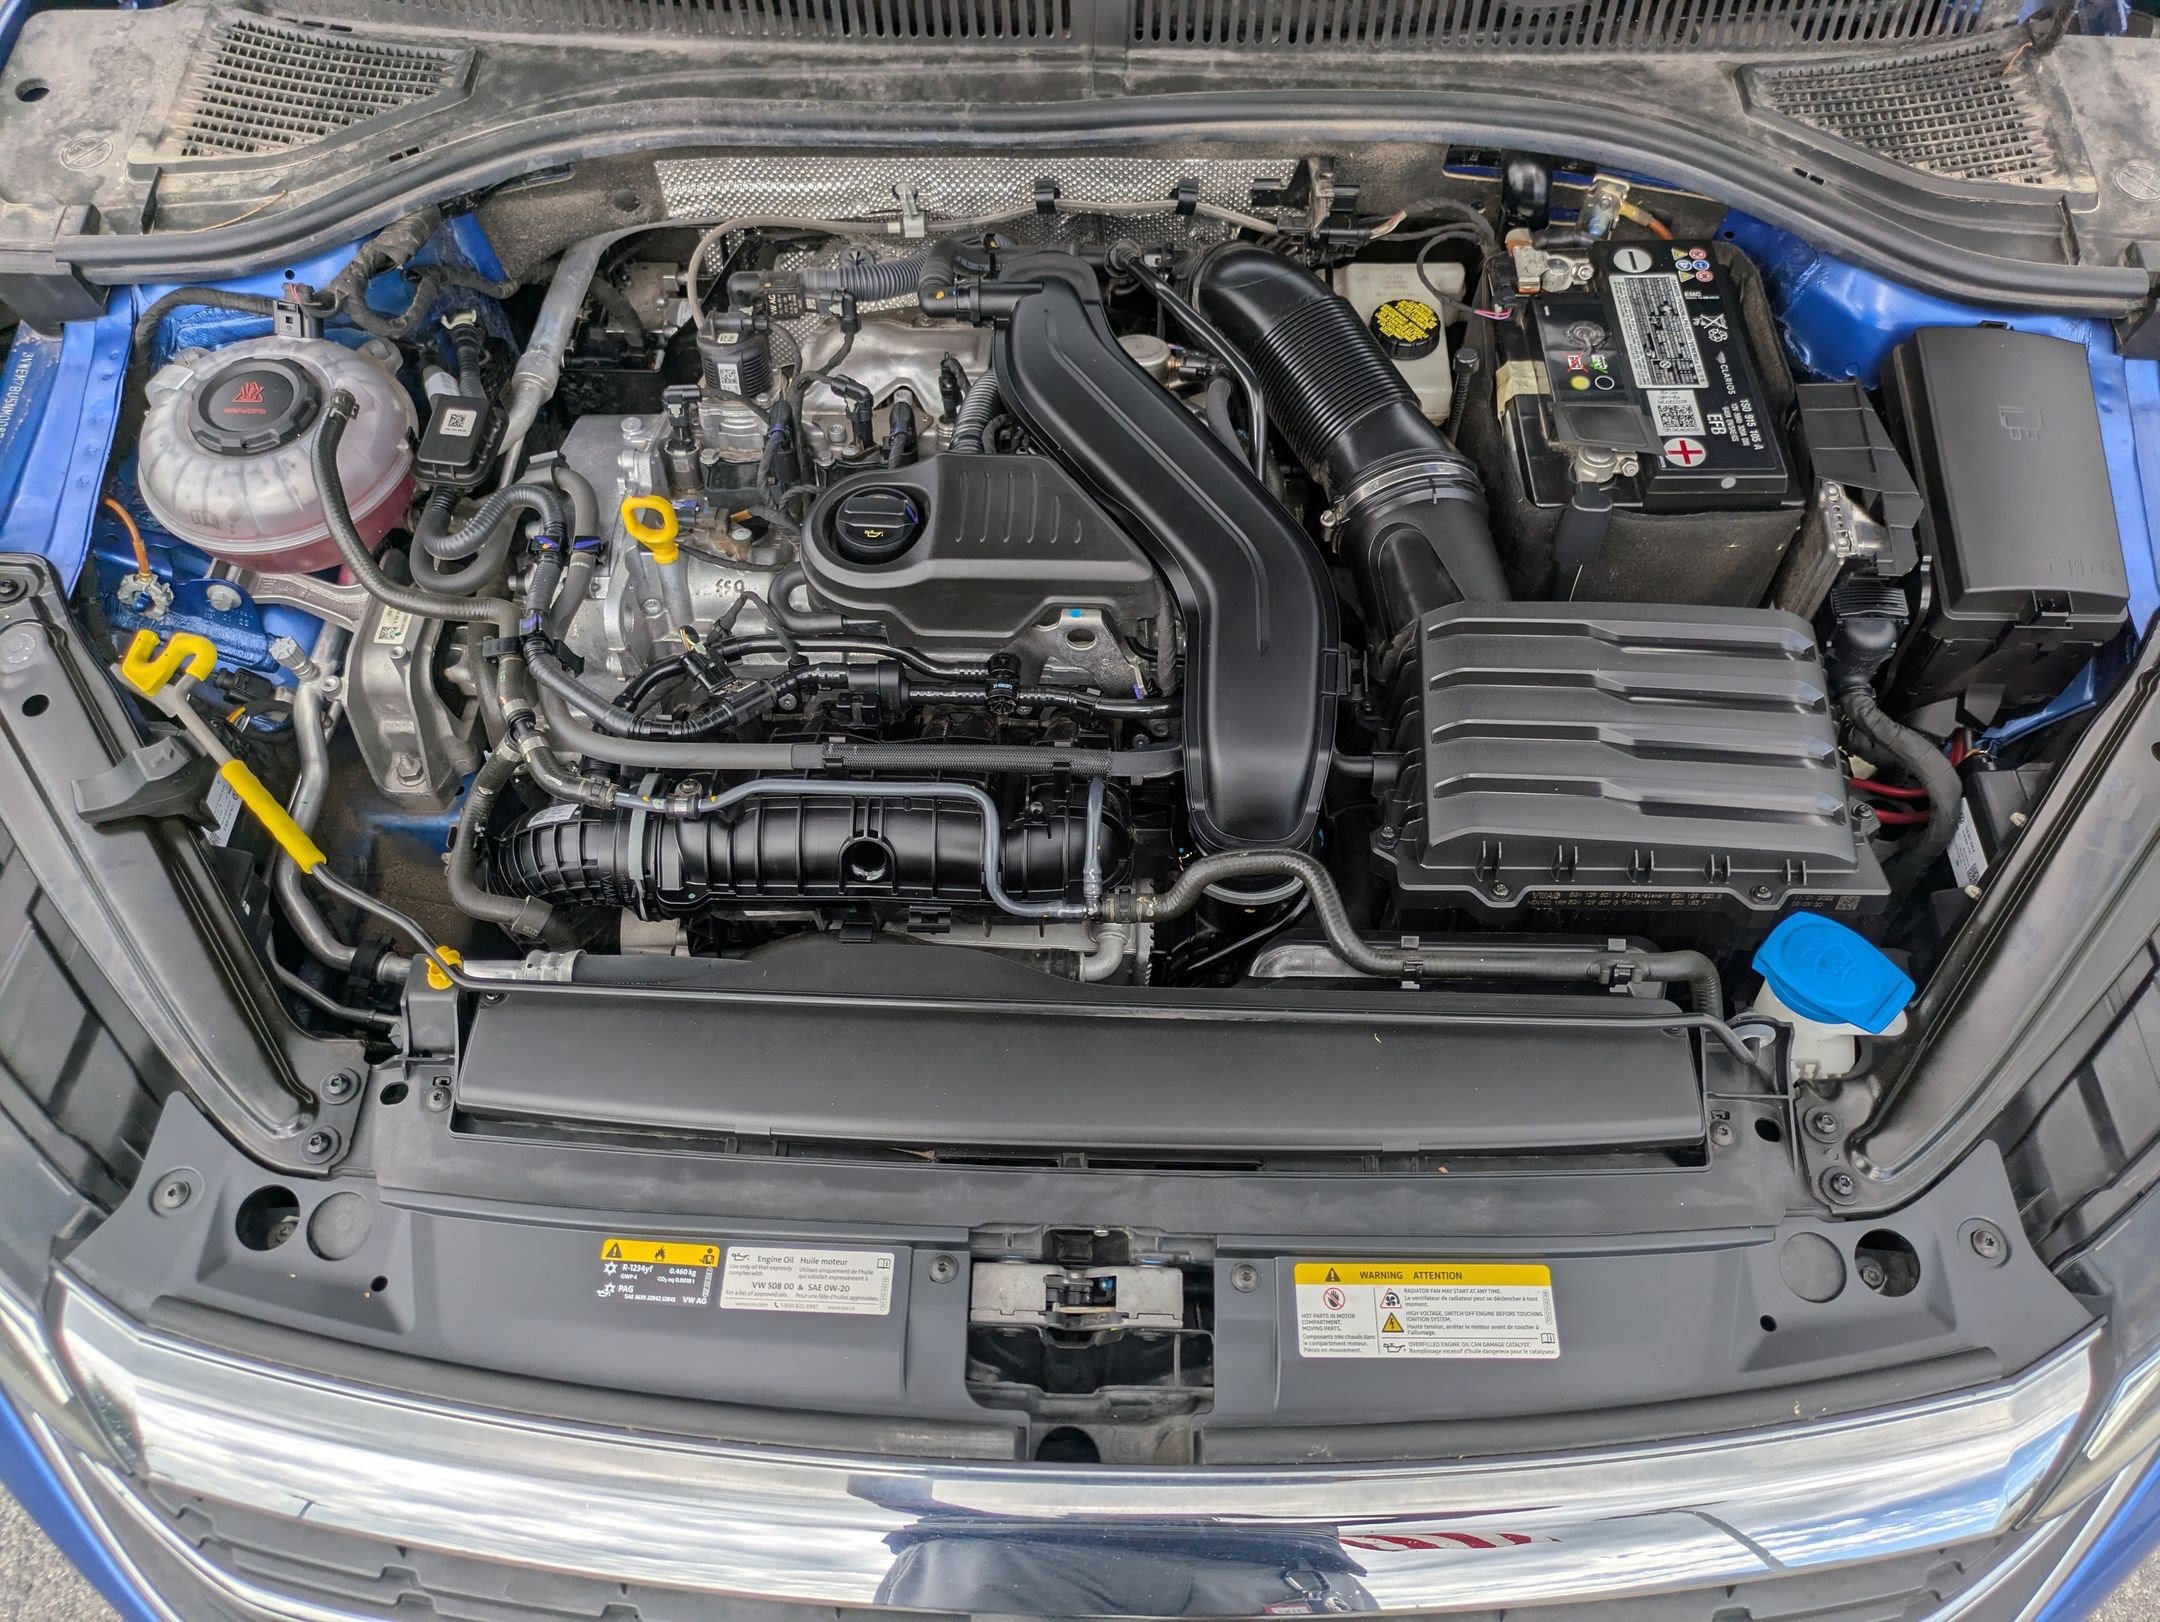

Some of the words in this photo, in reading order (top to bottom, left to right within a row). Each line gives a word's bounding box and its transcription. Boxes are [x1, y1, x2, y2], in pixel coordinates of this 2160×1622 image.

[1720, 364, 1737, 395] CLARIOS
[1706, 413, 1727, 435] EFB
[757, 1255, 782, 1264] Engine
[783, 1256, 794, 1264] Oil
[800, 1257, 819, 1265] Huile
[821, 1258, 848, 1266] moteur
[622, 1264, 654, 1275] R-1234yf
[669, 1268, 687, 1276] 0.460
[689, 1268, 697, 1277] kg
[1359, 1271, 1403, 1280] WARNING
[1413, 1271, 1463, 1280] ATTENTION
[618, 1285, 634, 1293] PAG
[752, 1281, 767, 1289] VW
[783, 1282, 795, 1290] 00
[682, 1296, 696, 1304] VW
[697, 1297, 707, 1305] AG
